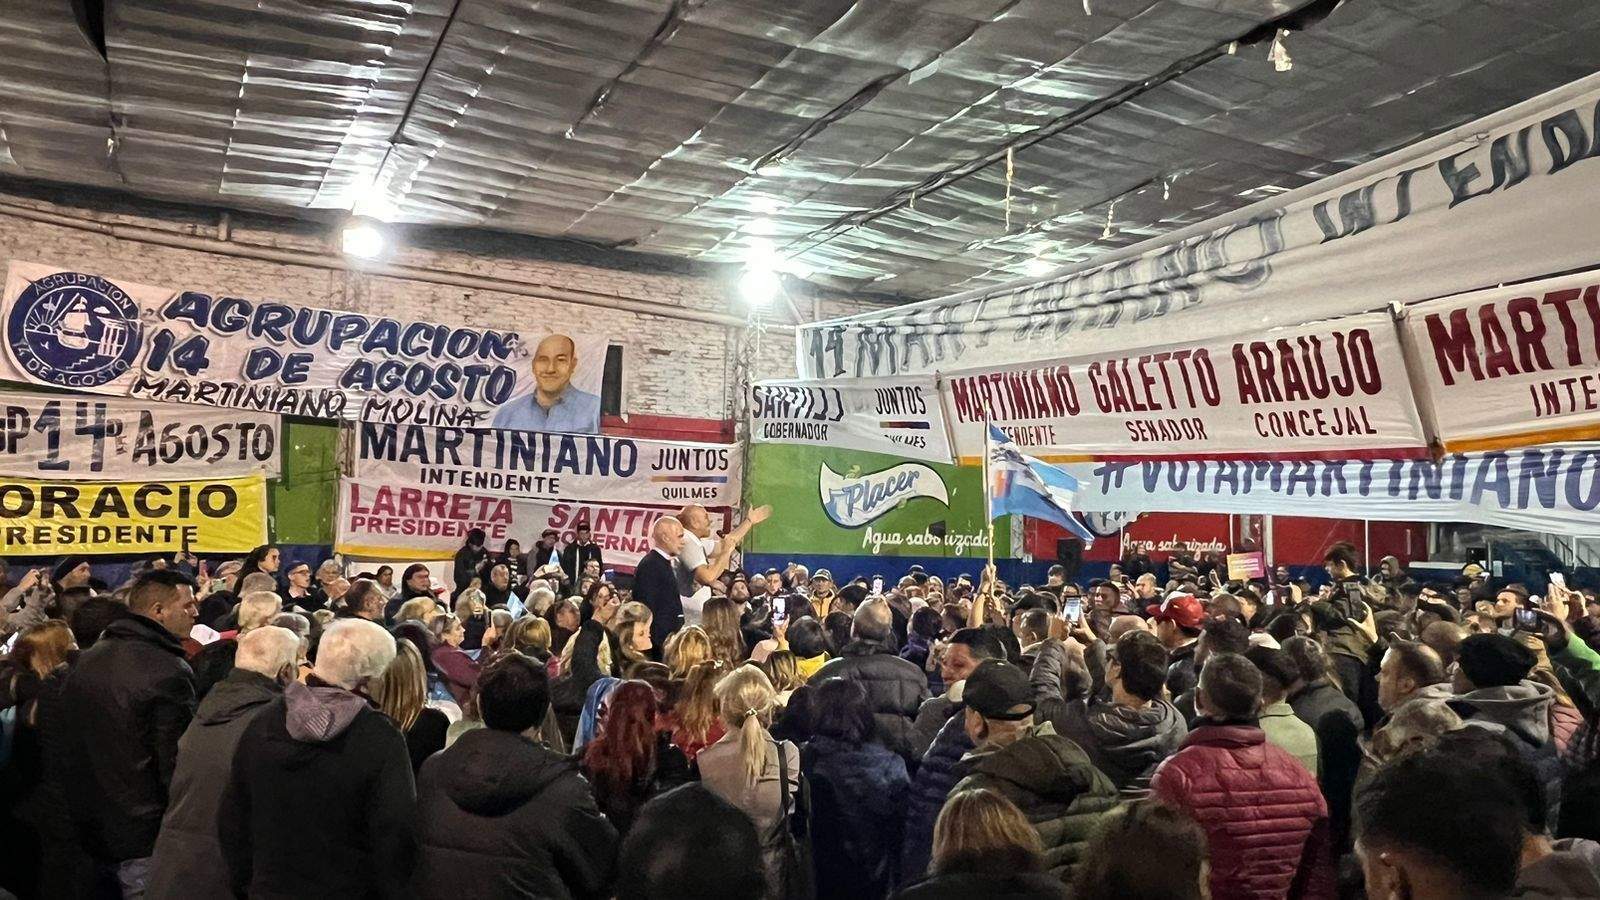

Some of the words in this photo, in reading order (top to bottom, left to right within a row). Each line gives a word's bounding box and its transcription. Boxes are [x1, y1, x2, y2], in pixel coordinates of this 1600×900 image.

[34, 274, 132, 310] AGRUPACION
[163, 291, 520, 360] AGRUPACION
[26, 357, 53, 379] DE
[56, 359, 131, 386] AGOSTO
[147, 328, 210, 376] 14
[246, 347, 314, 384] DE
[340, 358, 516, 405] AGOSTO
[951, 365, 1081, 423] MARTINIANO
[1088, 348, 1221, 414] GALETTO
[1231, 328, 1382, 404] ARAUJO
[132, 378, 347, 417] MARTINIANO
[363, 398, 477, 427] MOLINA
[875, 386, 927, 416] JUNTOS
[1530, 373, 1600, 417] INTE
[34, 401, 107, 472] 14
[132, 410, 274, 466] AGOSTO
[1125, 417, 1208, 441] SENADOR
[1254, 405, 1377, 438] CONCEJAL
[360, 423, 638, 478] MARTINIANO
[651, 448, 729, 471] JUNTOS
[420, 468, 560, 494] INTENDENTE
[661, 487, 718, 500] QUILMES
[842, 470, 920, 519] Placer
[0, 484, 238, 518] ORACIO
[350, 484, 513, 524] LARRETA
[0, 525, 198, 545] RESIDENTE
[548, 503, 664, 537] SANTI
[862, 526, 905, 555] Agua
[1158, 533, 1227, 561] sabrizada
